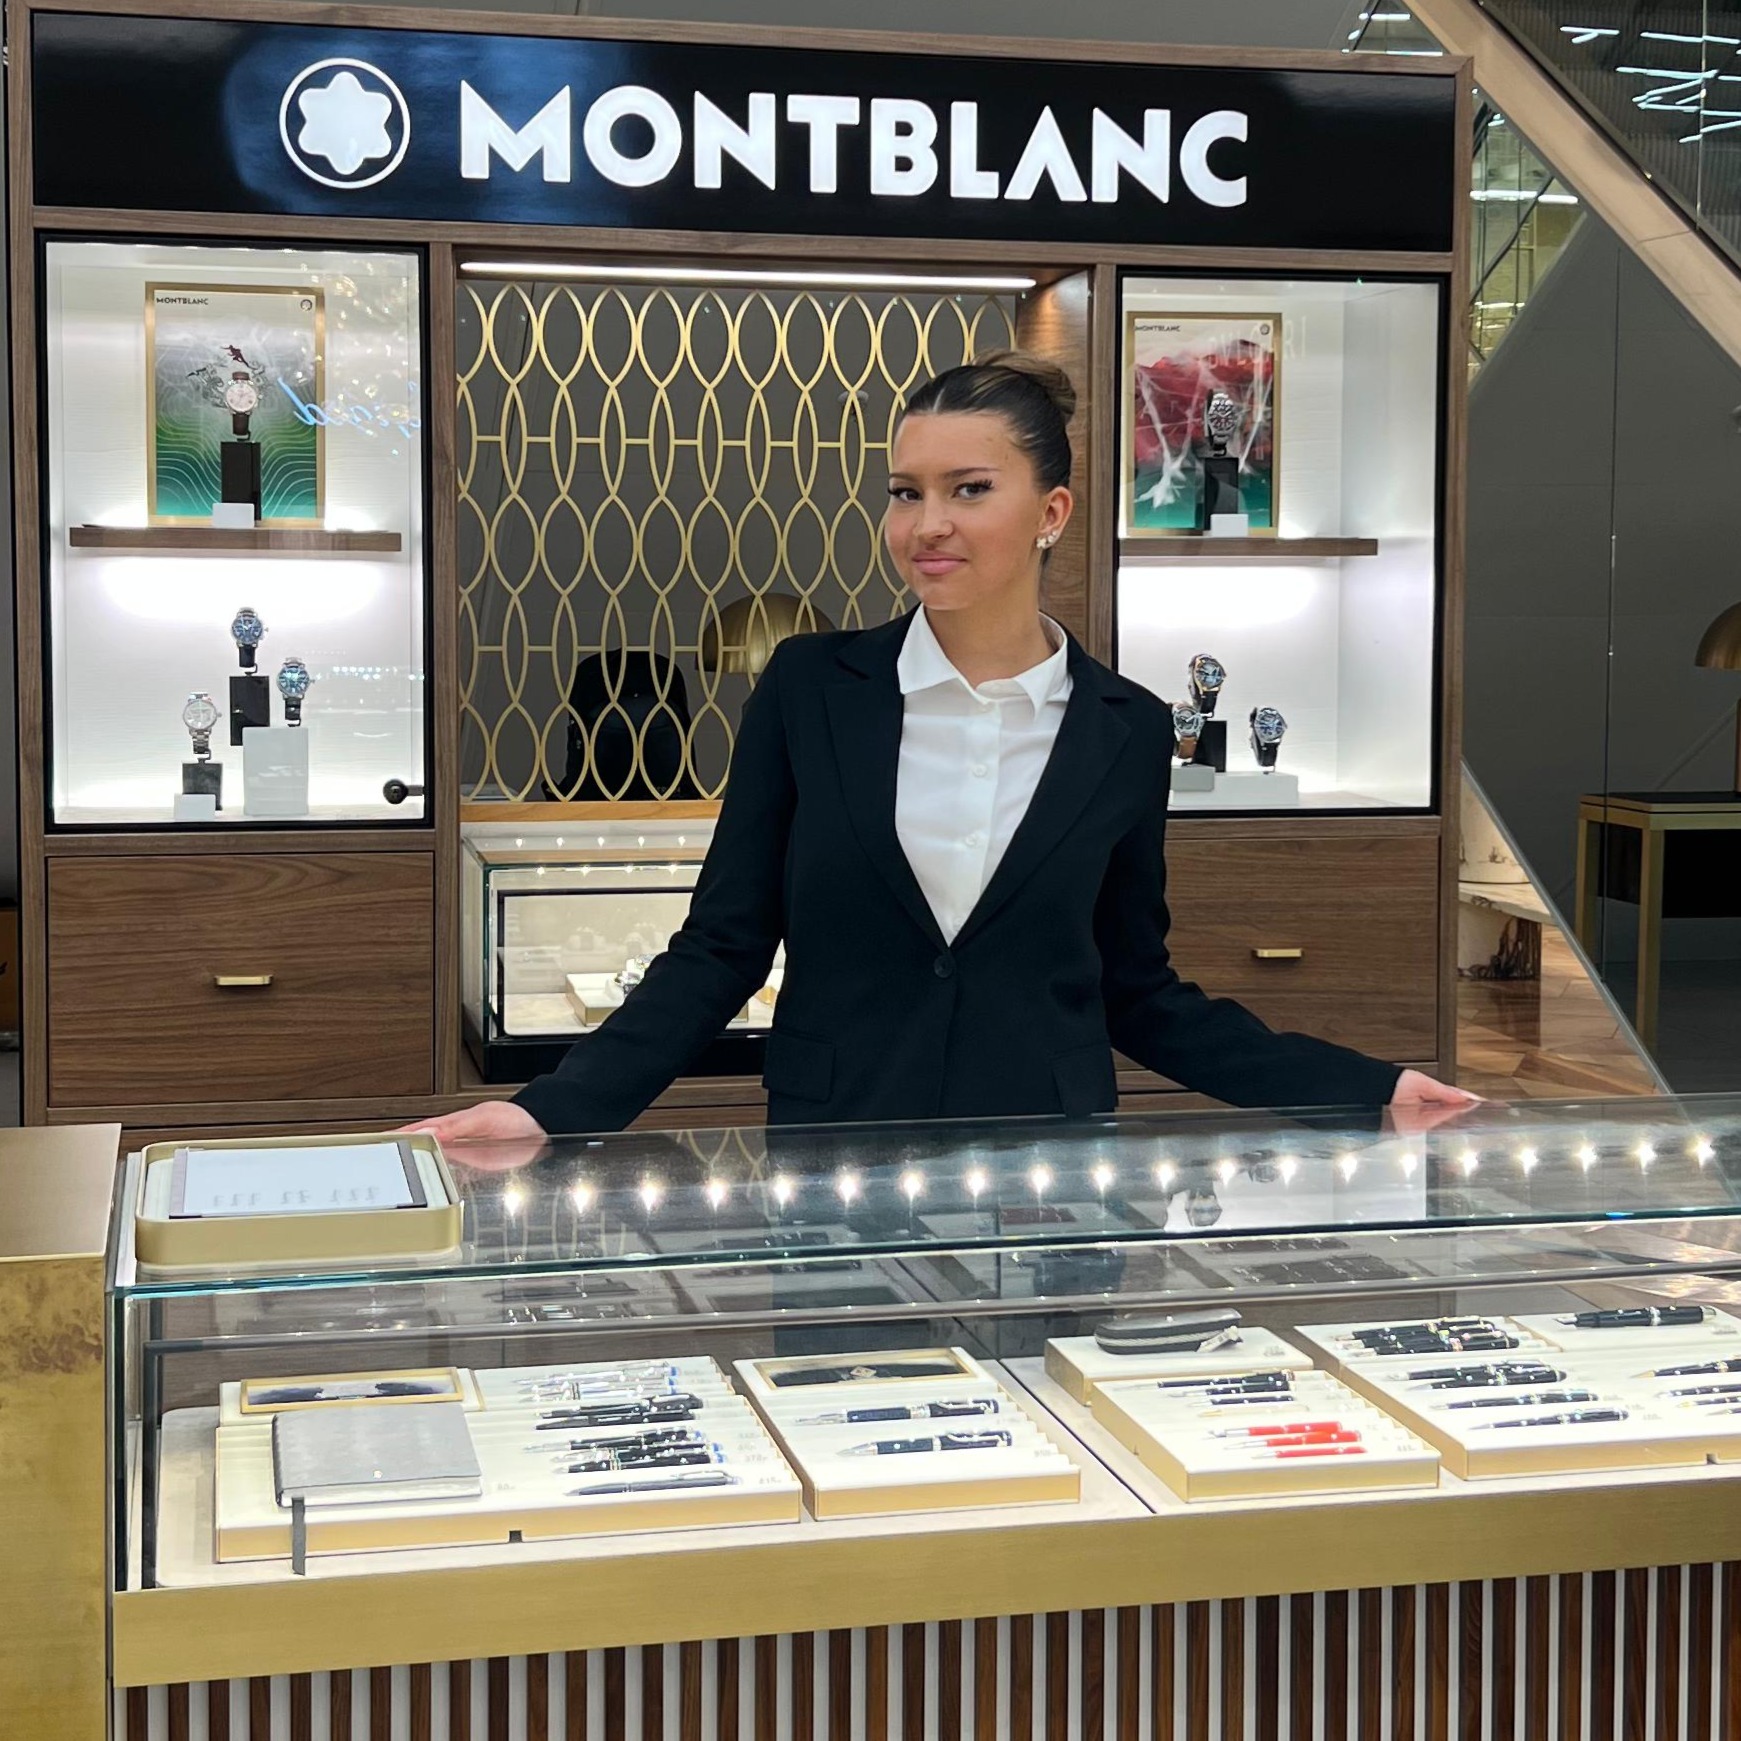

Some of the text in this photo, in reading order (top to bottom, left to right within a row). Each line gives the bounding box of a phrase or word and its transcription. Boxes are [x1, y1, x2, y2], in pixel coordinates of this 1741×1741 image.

[460, 80, 1248, 208] MONTBLANC
[155, 297, 209, 306] MONTBLANC
[1134, 325, 1181, 333] MONTBLANC
